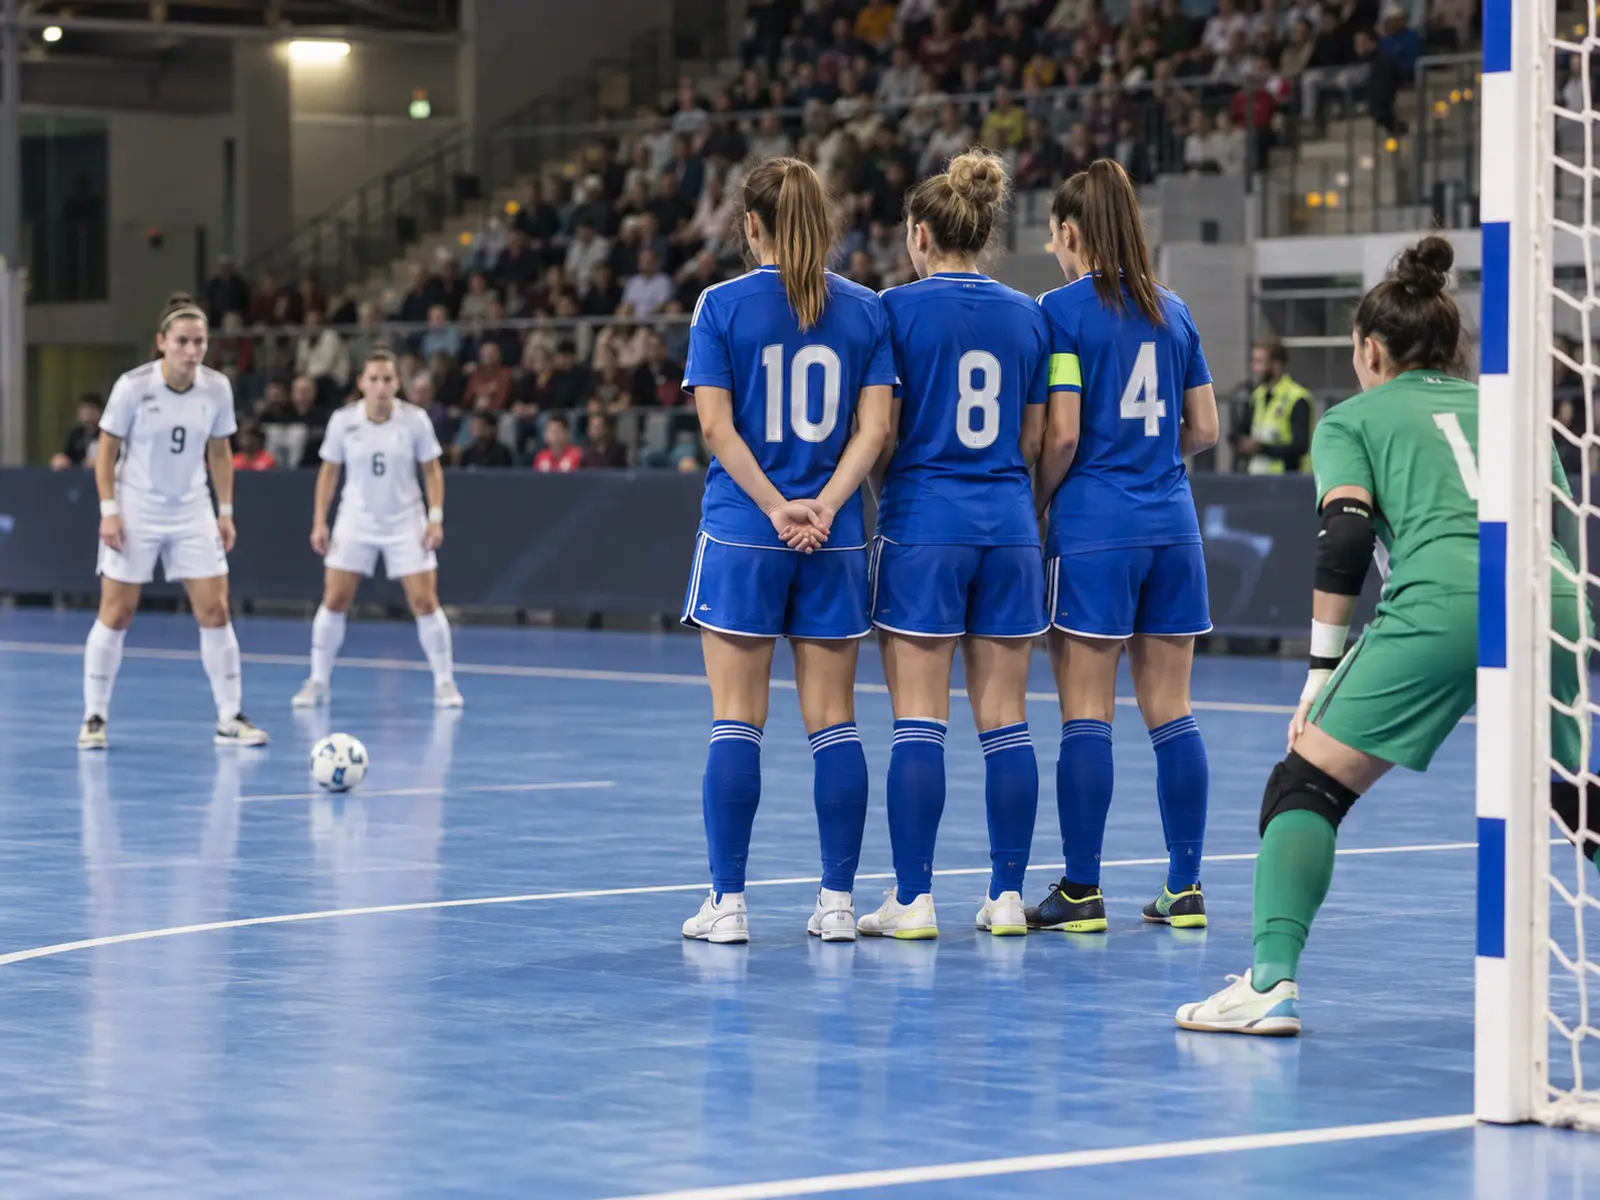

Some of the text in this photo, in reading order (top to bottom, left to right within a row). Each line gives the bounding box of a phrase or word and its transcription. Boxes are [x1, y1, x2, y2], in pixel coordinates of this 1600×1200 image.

[762, 343, 841, 443] 10
[956, 350, 1001, 449] 8
[1120, 341, 1166, 436] 4
[170, 426, 186, 454] 9
[372, 452, 386, 477] 6
[1432, 412, 1480, 501] 1
